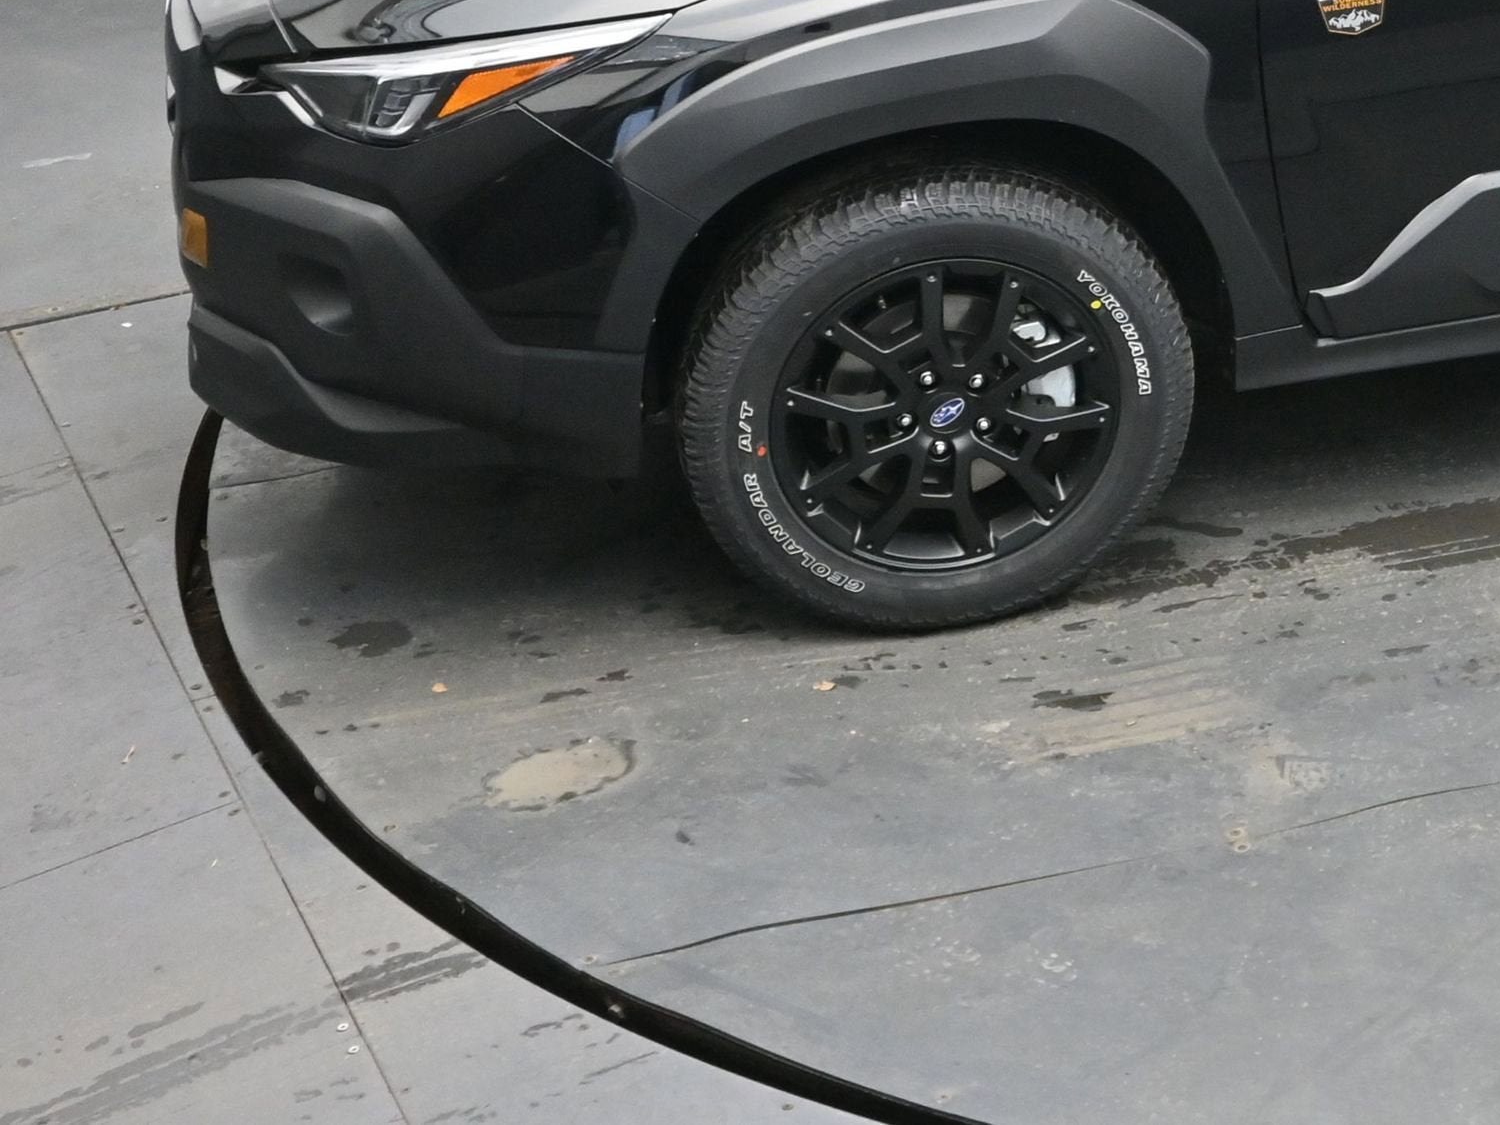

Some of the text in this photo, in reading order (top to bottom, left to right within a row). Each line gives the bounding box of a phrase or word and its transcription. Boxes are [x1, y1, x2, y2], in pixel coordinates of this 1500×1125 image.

[1076, 269, 1152, 395] YOKOHAMA
[738, 400, 866, 593] GEOLANDAR A/T
